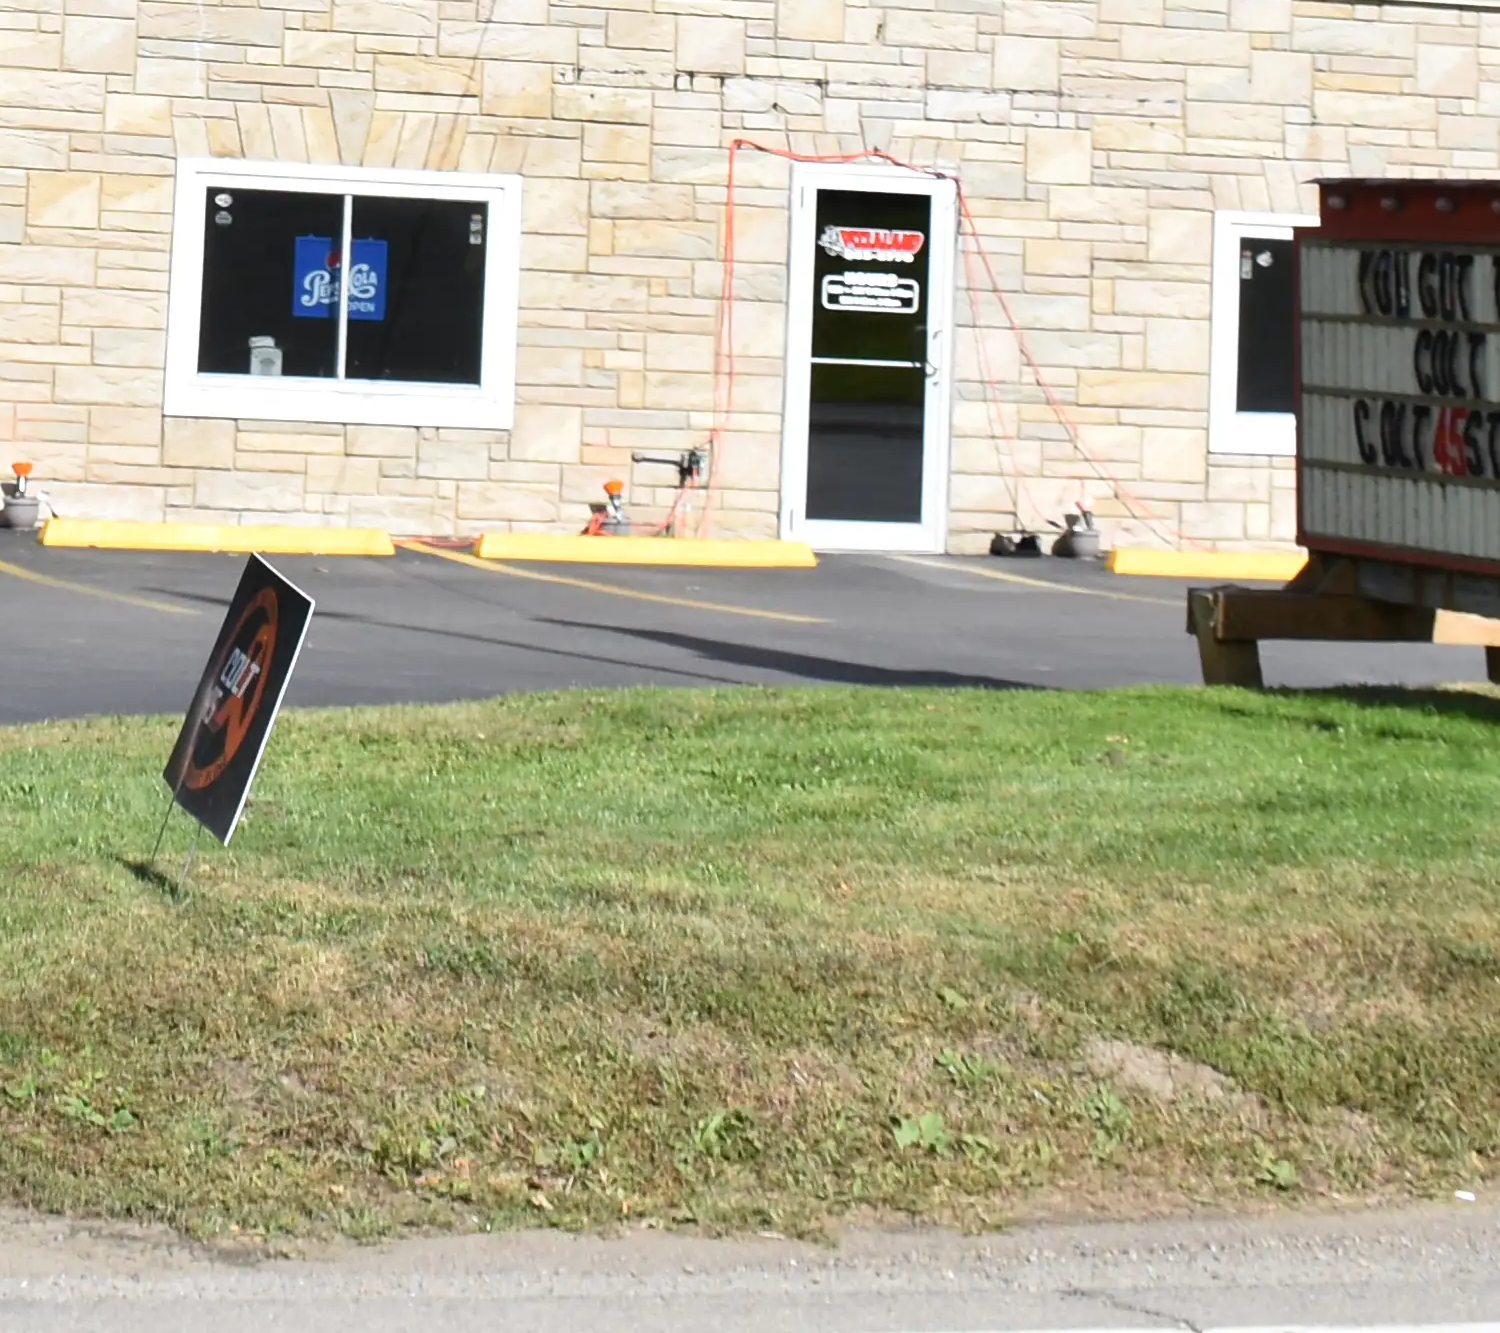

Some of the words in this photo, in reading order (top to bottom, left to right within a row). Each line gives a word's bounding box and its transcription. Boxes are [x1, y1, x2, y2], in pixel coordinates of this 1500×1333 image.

[1358, 250, 1411, 318] YOU
[1418, 252, 1474, 321] GOT
[1415, 329, 1485, 397] COLT
